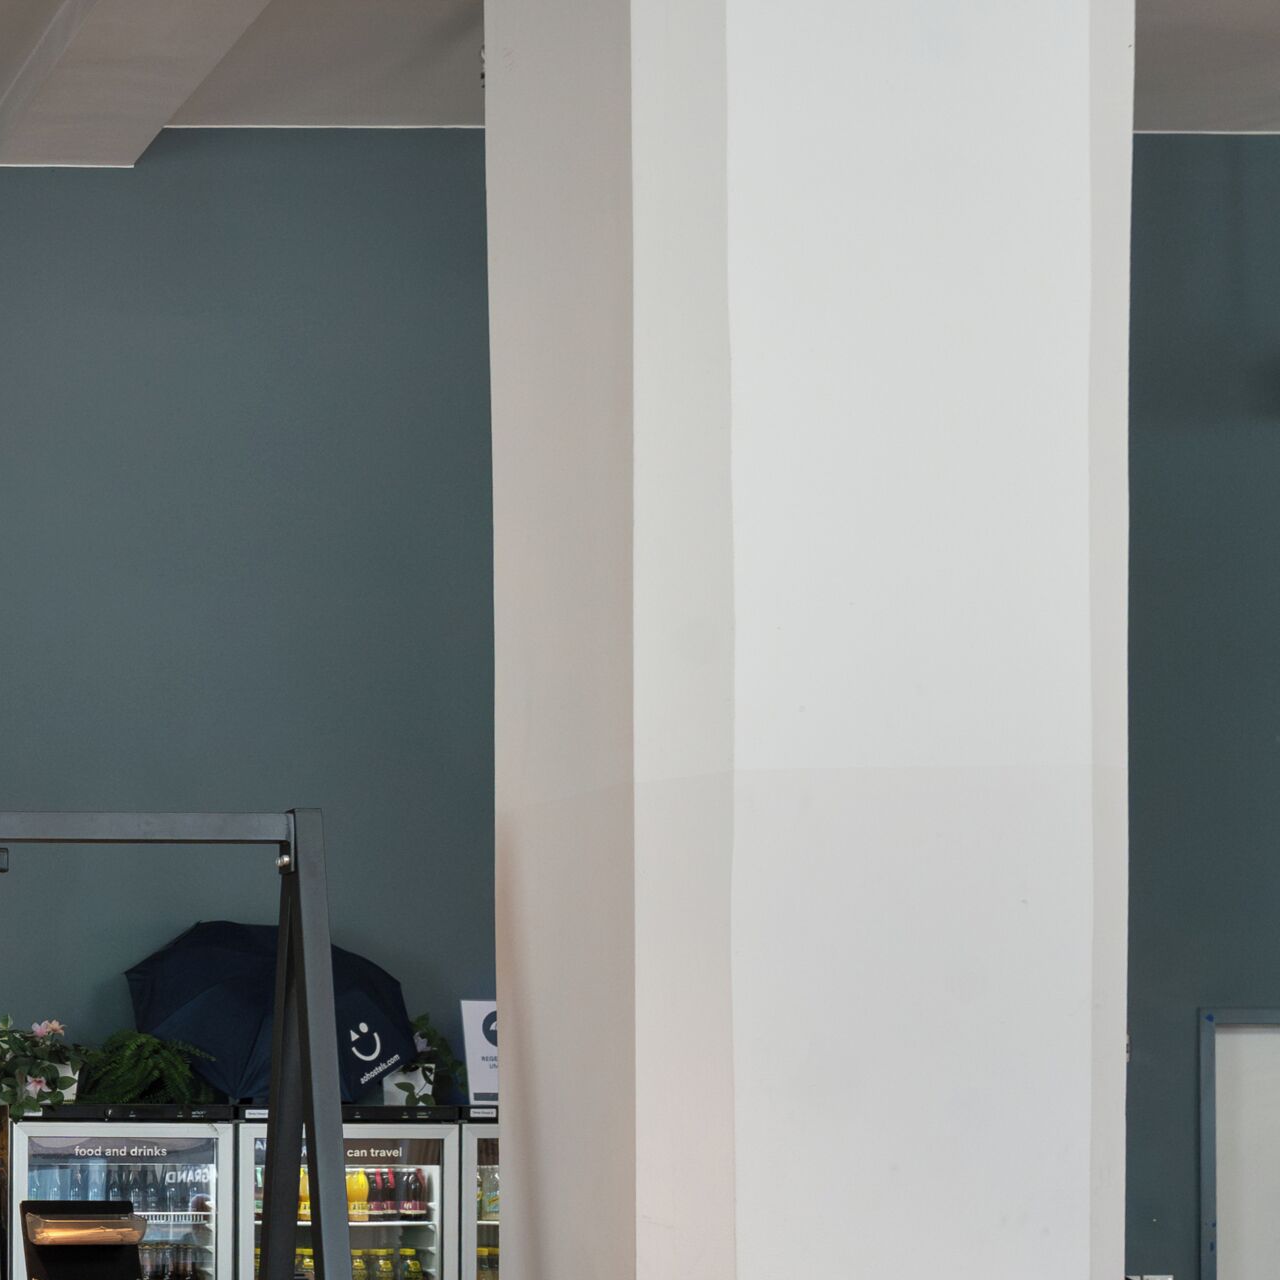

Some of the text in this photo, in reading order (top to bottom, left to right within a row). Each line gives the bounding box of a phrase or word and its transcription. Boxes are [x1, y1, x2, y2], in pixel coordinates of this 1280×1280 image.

[74, 1146, 167, 1157] food and drinks
[346, 1147, 403, 1158] can travel
